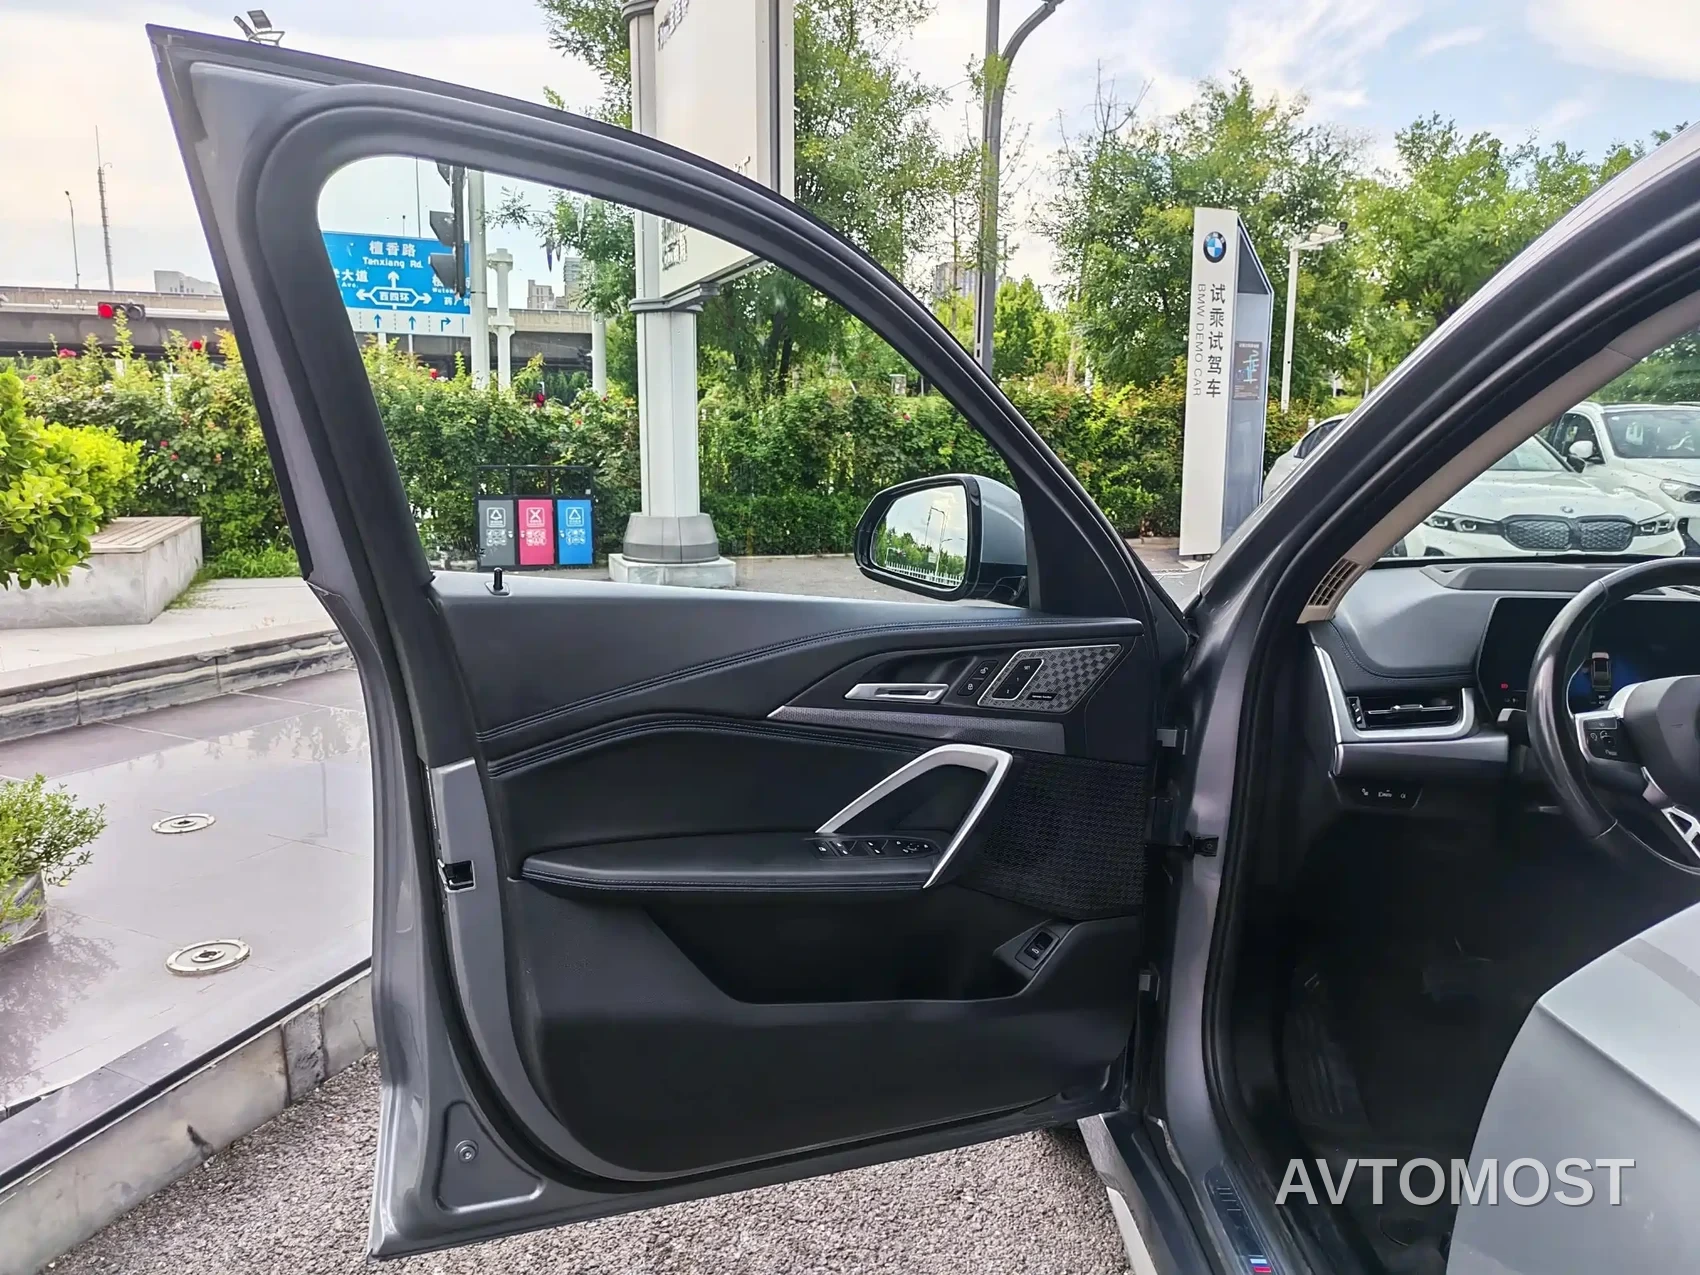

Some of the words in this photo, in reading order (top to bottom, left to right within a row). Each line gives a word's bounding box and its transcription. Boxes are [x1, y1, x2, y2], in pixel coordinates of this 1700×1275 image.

[362, 256, 405, 269] Tanxiang
[410, 260, 424, 269] Rd.
[369, 240, 416, 258] 檀香路
[379, 291, 410, 303] 西四环
[1196, 284, 1206, 317] BMW
[1194, 323, 1205, 363] DEMO
[1205, 283, 1226, 398] 试乘试驾车
[1192, 368, 1202, 397] CAR
